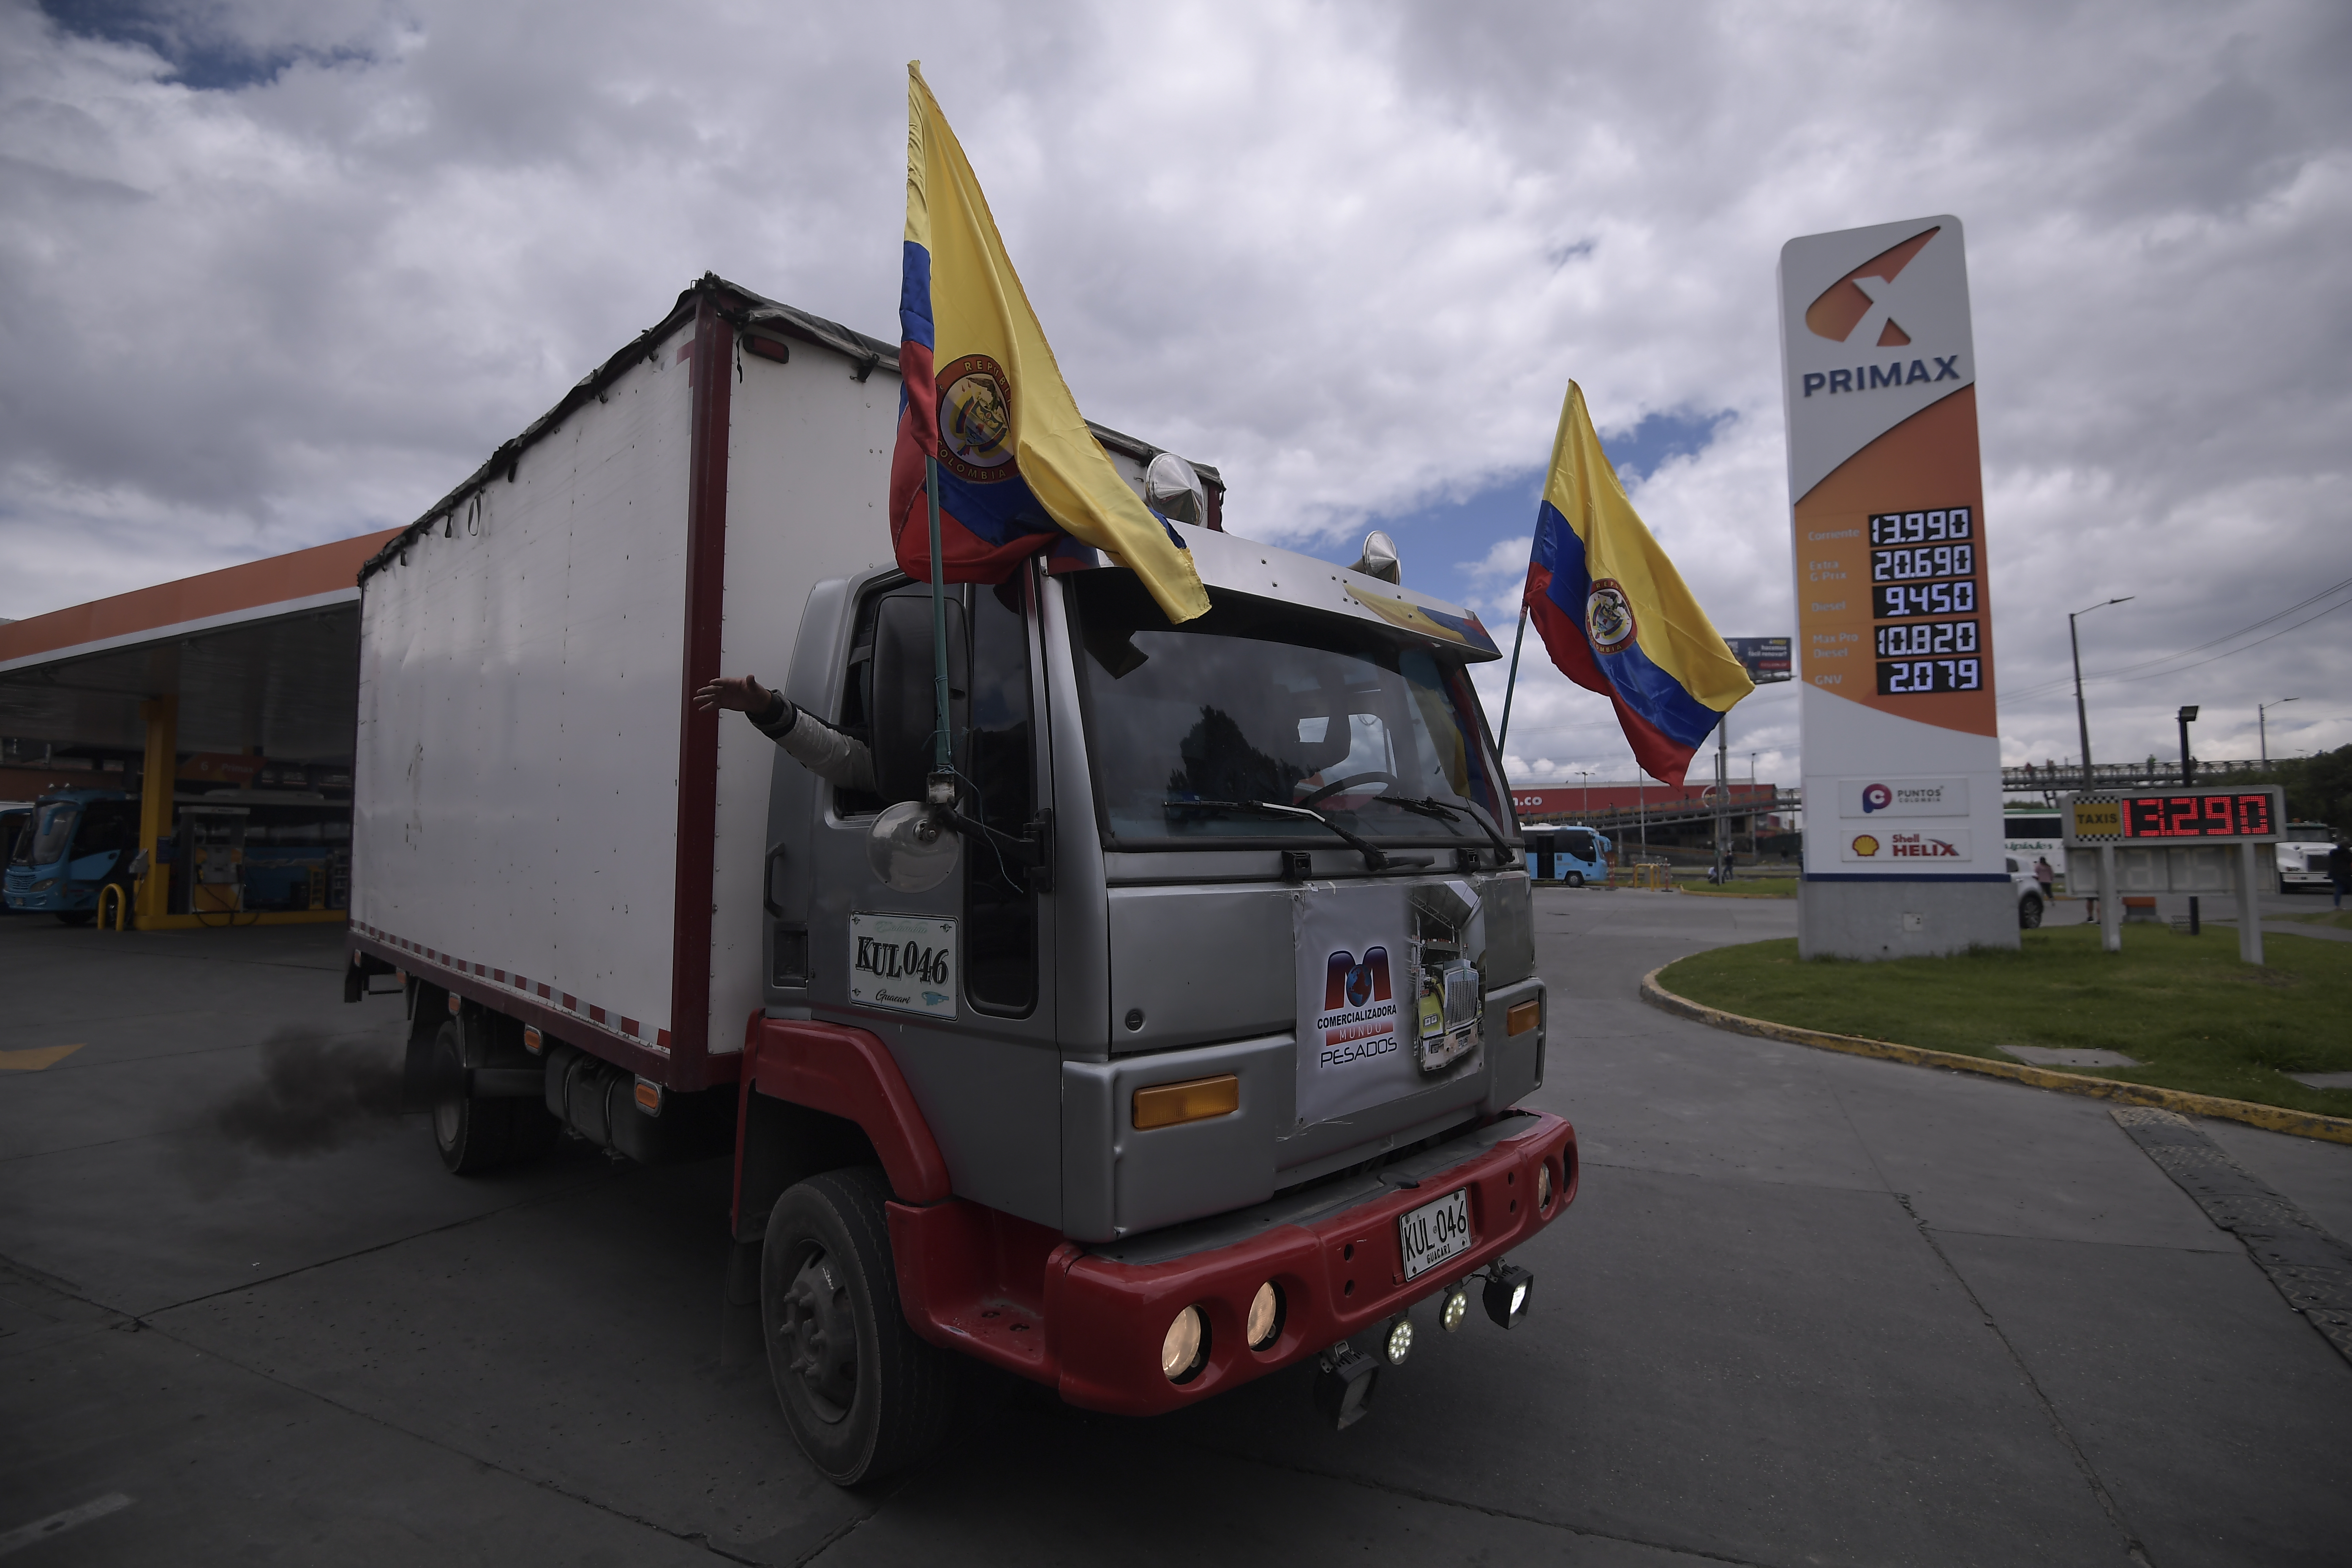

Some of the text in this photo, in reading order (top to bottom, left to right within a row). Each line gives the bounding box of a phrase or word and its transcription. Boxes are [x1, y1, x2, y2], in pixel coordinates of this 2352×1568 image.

[964, 360, 1011, 402] REPUBLI
[1803, 354, 1960, 397] PRIMAX
[1808, 509, 1969, 544] Corriente 13.990
[1810, 544, 1972, 581] G-Prix 20.690
[1810, 560, 1839, 570] Extra
[1812, 581, 1973, 616] Diesel 9.450
[1813, 621, 1976, 656] Max Pro 10.820
[1814, 648, 1848, 659] Diesel
[1815, 659, 1979, 693] GNV 2.079
[221, 763, 254, 773] Primax
[1897, 789, 1941, 797] PUNTOS
[2077, 813, 2118, 824] TAXIS
[1892, 833, 1920, 843] Shell
[1892, 844, 1959, 856] HELIX
[855, 936, 949, 985] KUL046
[1317, 1004, 1397, 1029] COMERCIALIZADORA
[1339, 1022, 1382, 1041] MUNDO
[1320, 1037, 1397, 1068] PESADOS
[1404, 1200, 1467, 1262] KUL 046
[1427, 1243, 1451, 1264] GUACARI
